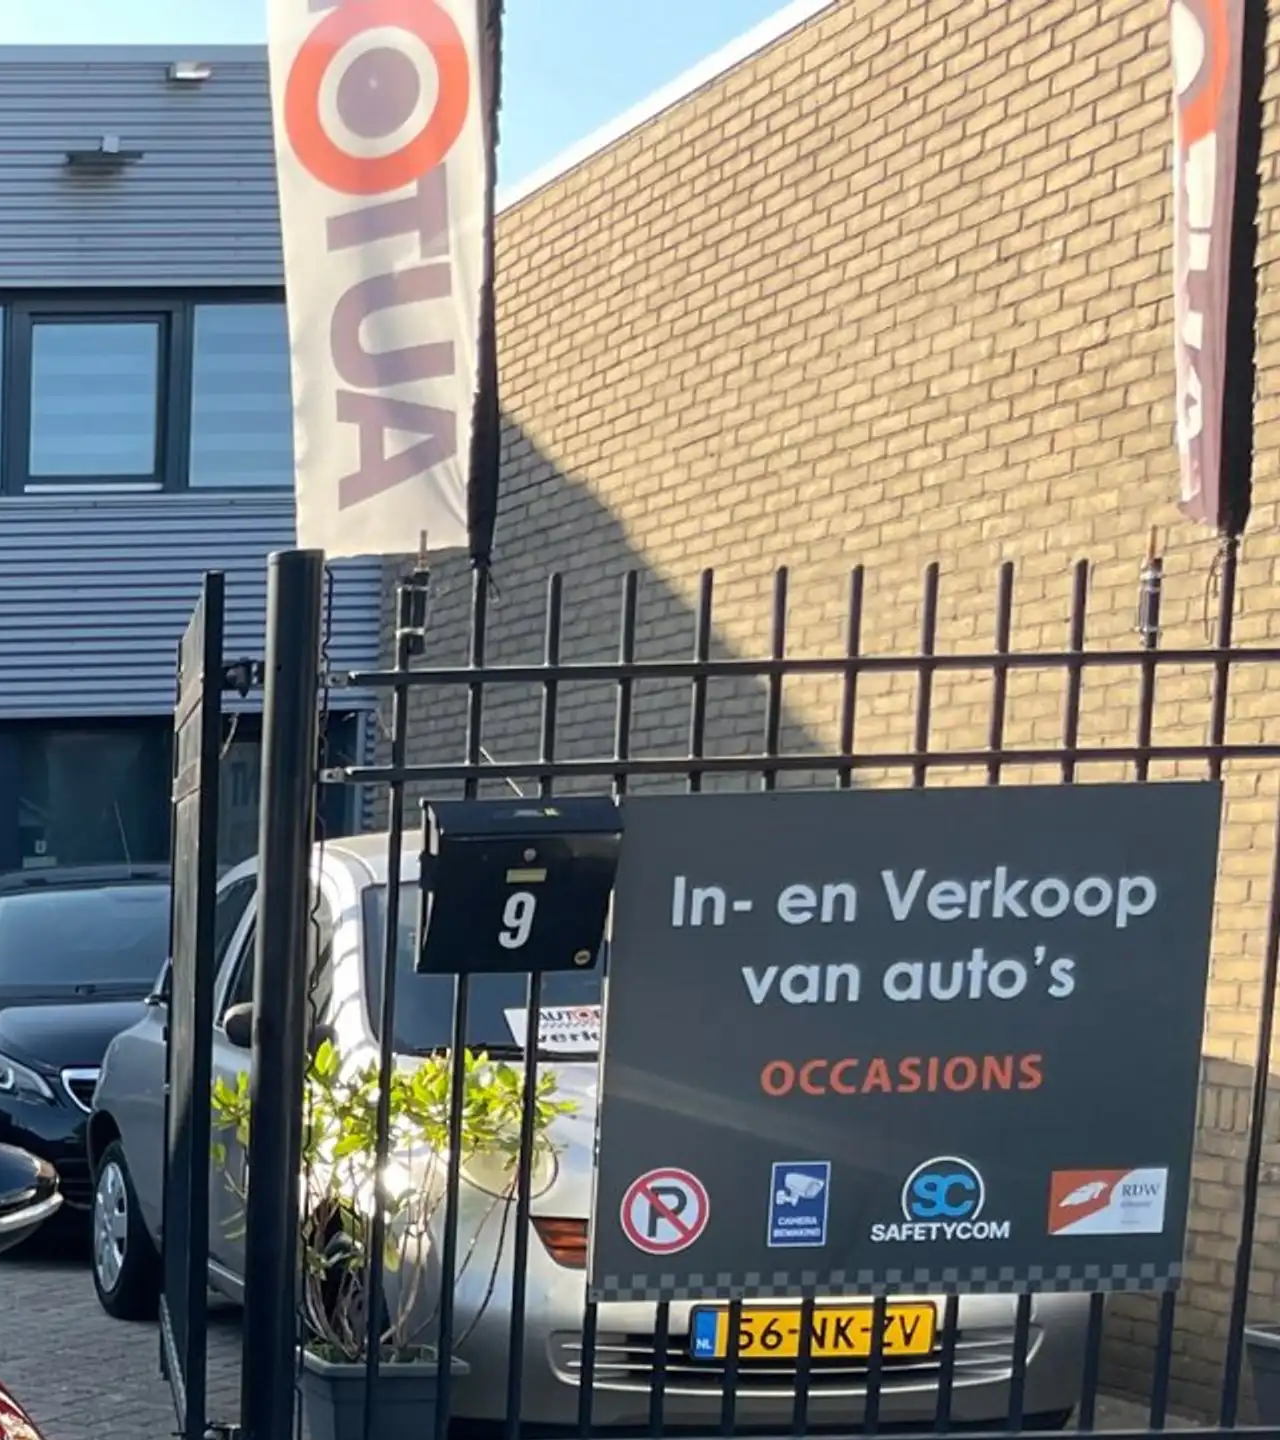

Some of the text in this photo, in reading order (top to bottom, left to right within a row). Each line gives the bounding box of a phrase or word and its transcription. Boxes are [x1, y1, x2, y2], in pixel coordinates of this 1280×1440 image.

[672, 865, 1157, 929] In- en Verkoop
[498, 891, 537, 949] 9
[741, 963, 860, 1006] van
[759, 1053, 1044, 1097] OCCASIONS
[1122, 1183, 1160, 1197] RDW
[870, 1220, 1011, 1242] SAFETYCOM
